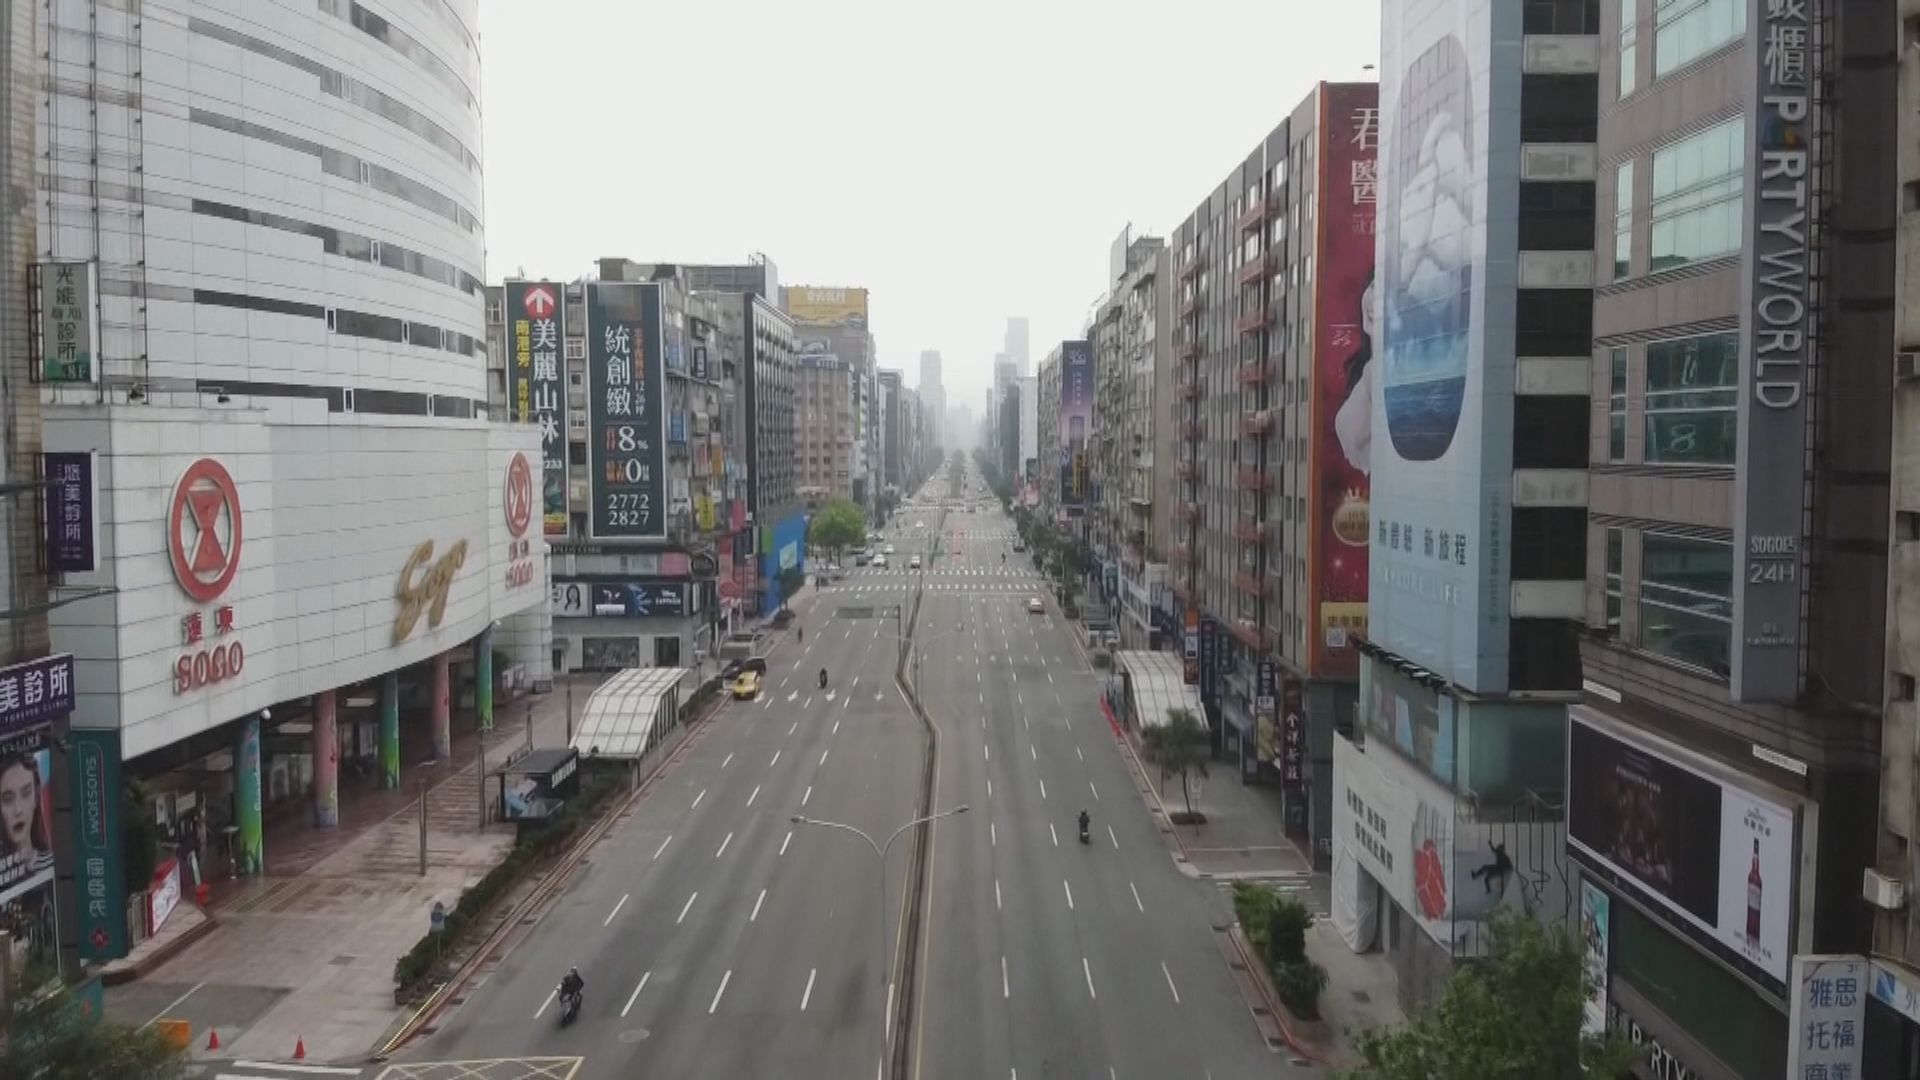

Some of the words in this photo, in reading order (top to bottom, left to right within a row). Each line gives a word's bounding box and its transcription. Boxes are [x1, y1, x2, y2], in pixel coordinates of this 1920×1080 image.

[605, 325, 631, 416] 統創緻
[607, 493, 649, 510] 2772
[608, 510, 650, 526] 2827
[1750, 562, 1795, 584] 24H
[180, 605, 235, 644] 遠東
[174, 640, 244, 695] SOGO
[85, 756, 98, 835] watsons
[1809, 976, 1857, 1010] 雅思
[1807, 1019, 1855, 1050] 托福
